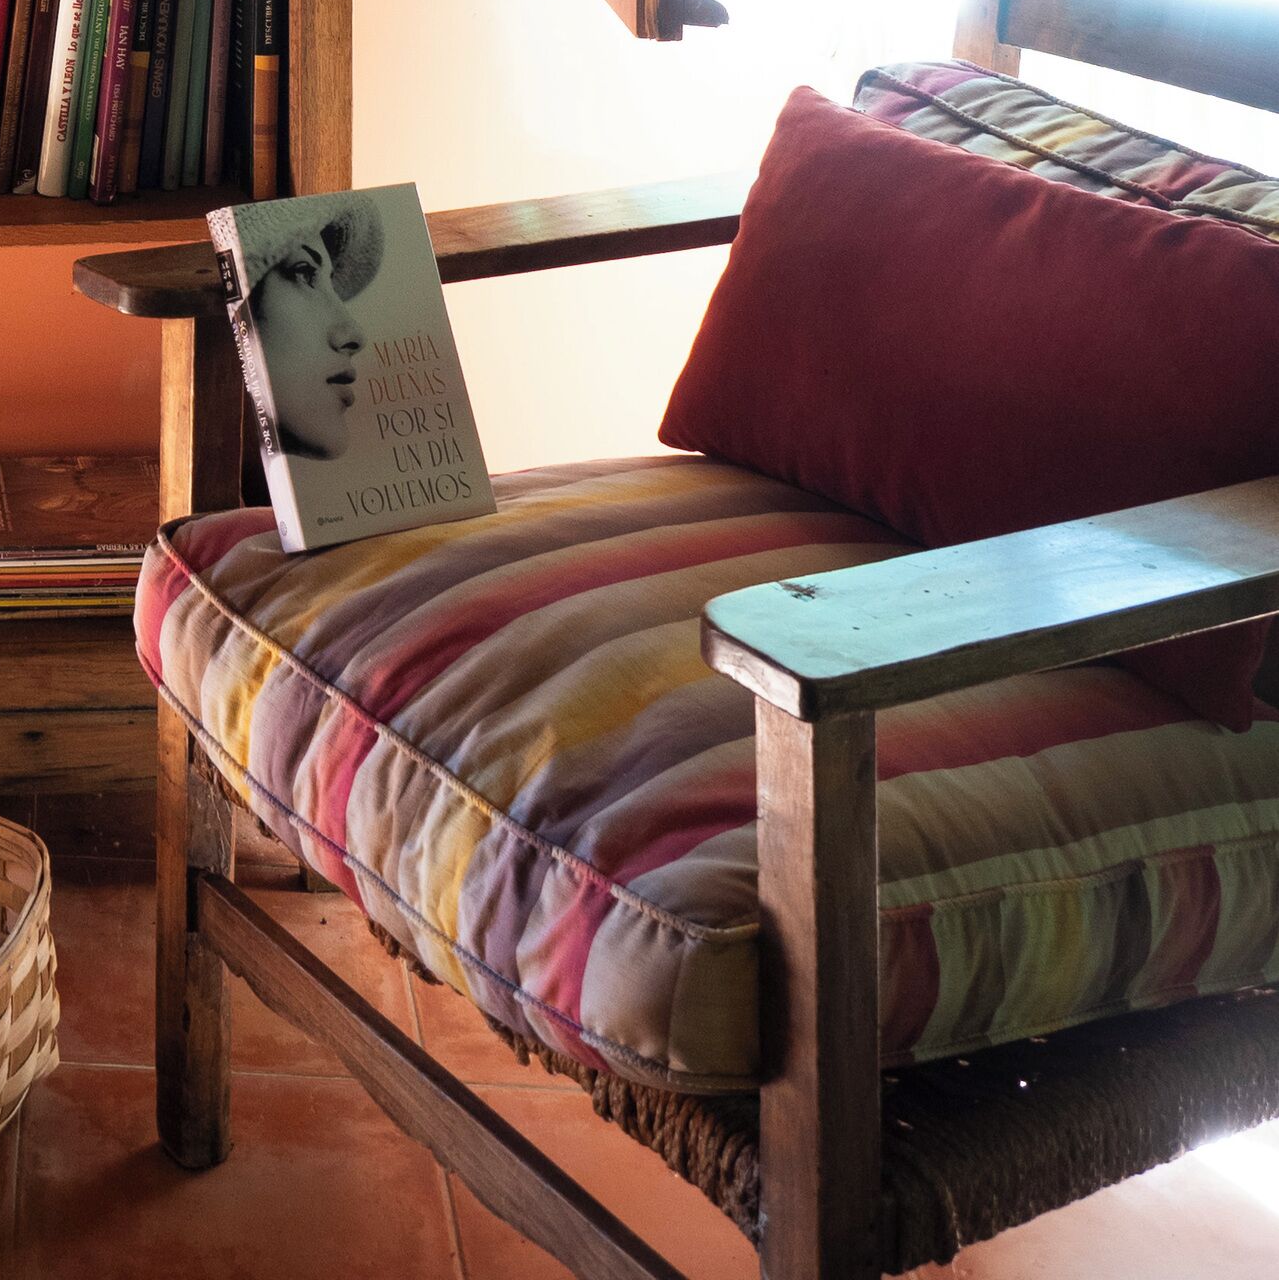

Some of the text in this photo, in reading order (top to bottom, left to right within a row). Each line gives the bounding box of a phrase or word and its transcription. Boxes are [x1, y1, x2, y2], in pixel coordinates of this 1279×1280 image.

[70, 24, 83, 39] que
[72, 11, 81, 22] se
[264, 0, 273, 45] DESCUBRA
[66, 40, 78, 52] Lo
[117, 24, 130, 45] IAN
[63, 57, 76, 84] LEON
[115, 48, 127, 70] HAY
[62, 86, 72, 94] Y
[84, 90, 94, 120] CULTURA
[89, 50, 99, 84] SOCIEDAD
[151, 58, 165, 98] GRANS
[56, 96, 72, 142] CASTILLA
[76, 160, 85, 179] folio
[374, 330, 440, 368] MARÍA
[368, 366, 446, 405] DUEÑAS
[376, 402, 455, 440] POR SI
[262, 434, 274, 456] POR
[392, 432, 464, 473] UN DÍA
[346, 471, 472, 518] VOLVEMOS
